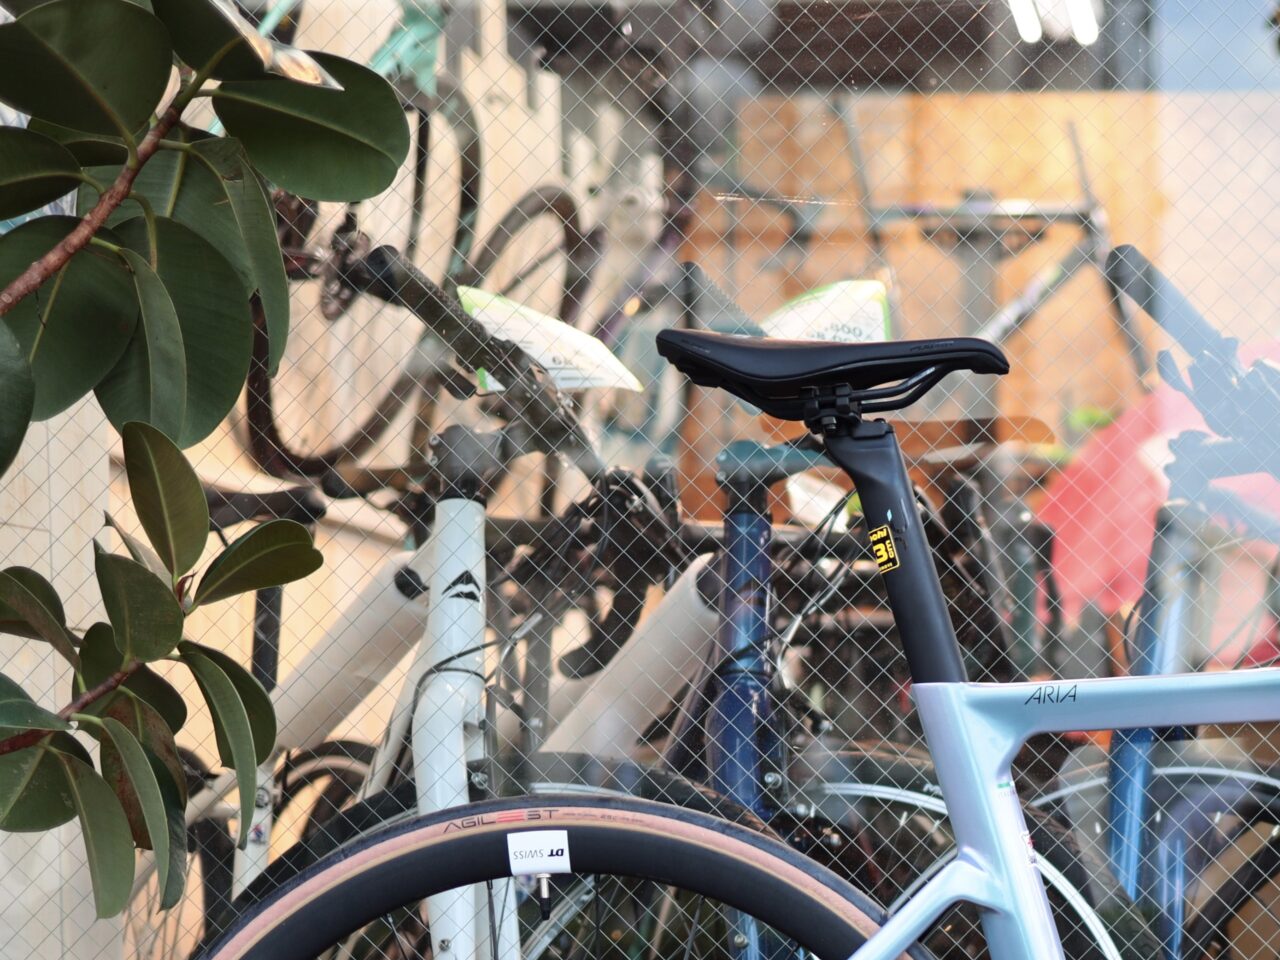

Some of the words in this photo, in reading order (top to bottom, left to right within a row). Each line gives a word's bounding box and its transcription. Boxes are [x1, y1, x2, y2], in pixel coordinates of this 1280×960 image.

[1024, 684, 1077, 705] ARIA
[512, 849, 544, 860] SWISS
[547, 848, 565, 857] DT
